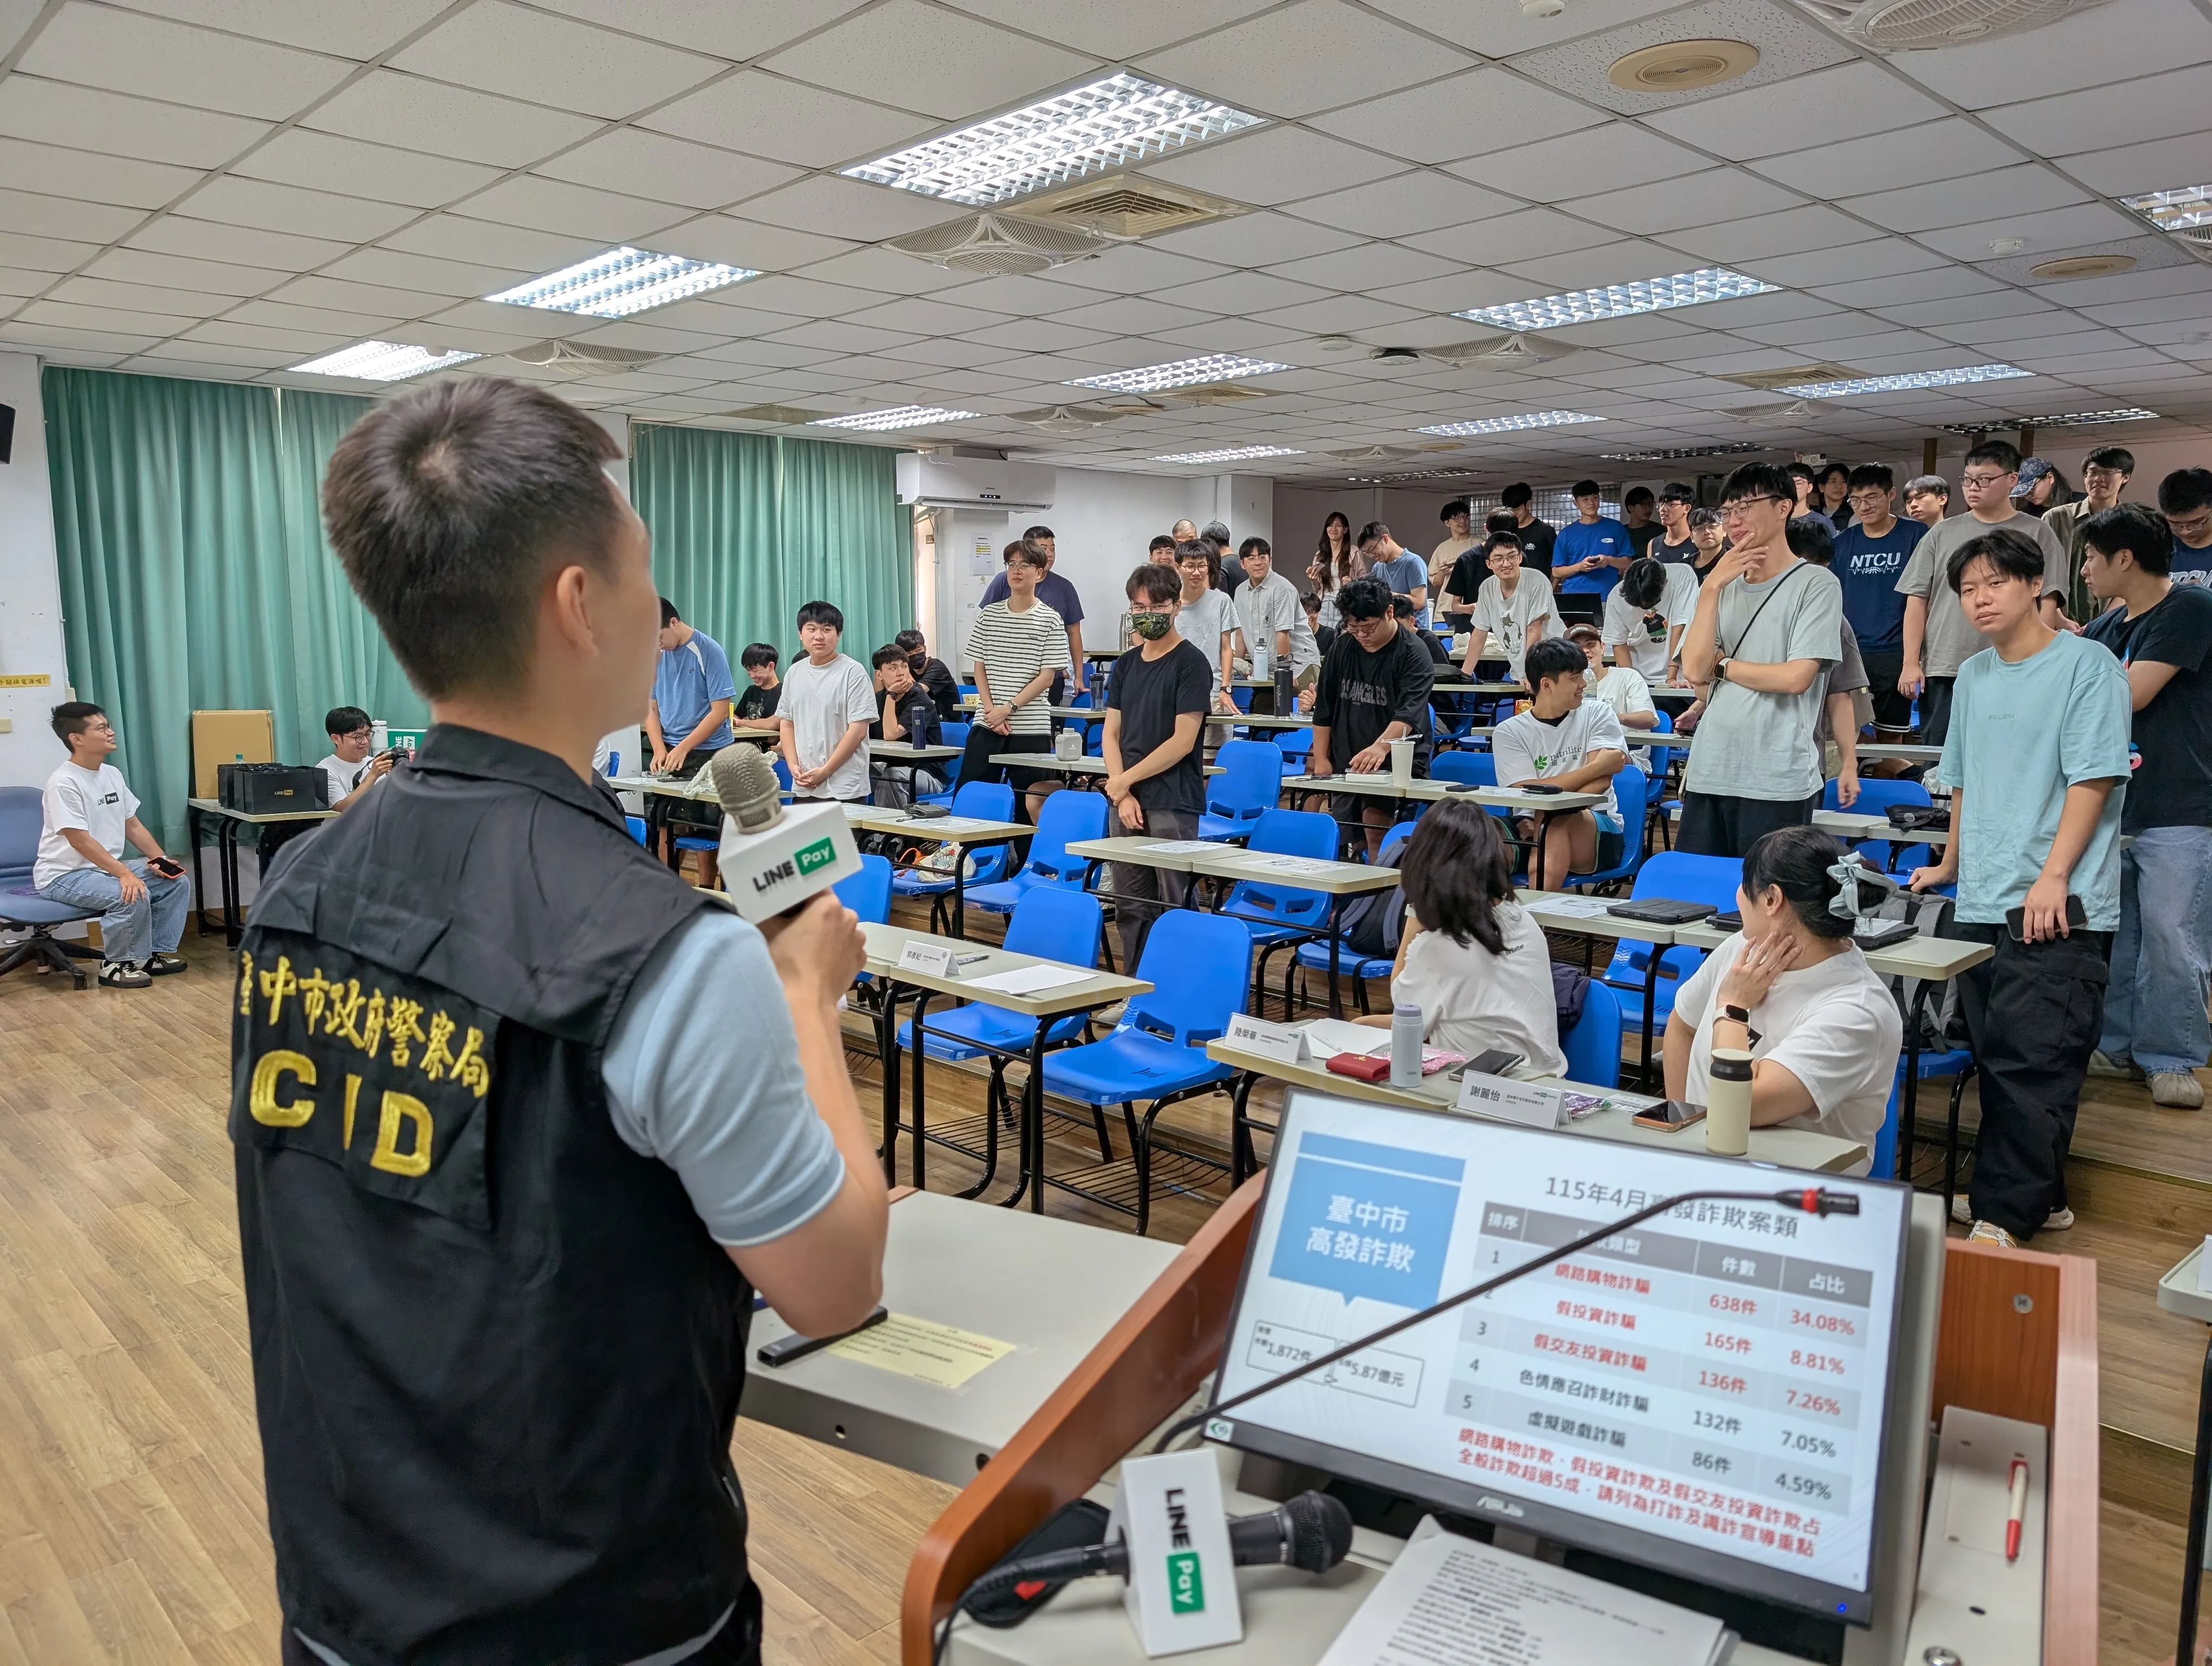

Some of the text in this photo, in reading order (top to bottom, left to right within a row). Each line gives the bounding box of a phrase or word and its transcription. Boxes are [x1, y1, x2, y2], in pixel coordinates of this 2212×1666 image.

[1850, 552, 1901, 568] NTCU
[1550, 746, 1582, 761] nutrilite
[97, 797, 105, 806] LINE
[752, 846, 830, 892] LINE Pay
[1470, 1085, 1501, 1102] 謝麗怡
[249, 1049, 433, 1177] CID
[1326, 1194, 1410, 1234] 臺中市
[1487, 1210, 1519, 1231] 排序
[1305, 1226, 1416, 1273] 高發詐欺
[1491, 1250, 1500, 1264] 1
[1554, 1262, 1650, 1295] 網路購物詐騙
[1721, 1255, 1757, 1277] 件數
[1808, 1273, 1846, 1295] 占比
[1556, 1300, 1637, 1330] 假投資詐騙
[1709, 1293, 1758, 1316] 638件
[1476, 1321, 1488, 1336] 3
[1790, 1309, 1855, 1336] 34.08%
[1533, 1332, 1647, 1372] 假交友投資詐騙
[1704, 1331, 1752, 1355] 165件
[1469, 1358, 1481, 1373] 4
[1790, 1349, 1845, 1375] 8.81%
[1699, 1370, 1747, 1394] 136件
[1462, 1394, 1473, 1409] 5
[1786, 1388, 1841, 1416] 7.26%
[1527, 1411, 1626, 1449] 虛擬遊戲詐騙
[1693, 1409, 1742, 1435] 132件
[1780, 1429, 1837, 1459] 7.05%
[1692, 1450, 1732, 1475] 86件
[1774, 1472, 1832, 1501] 4.59%
[1165, 1488, 1195, 1605] LINE Pay
